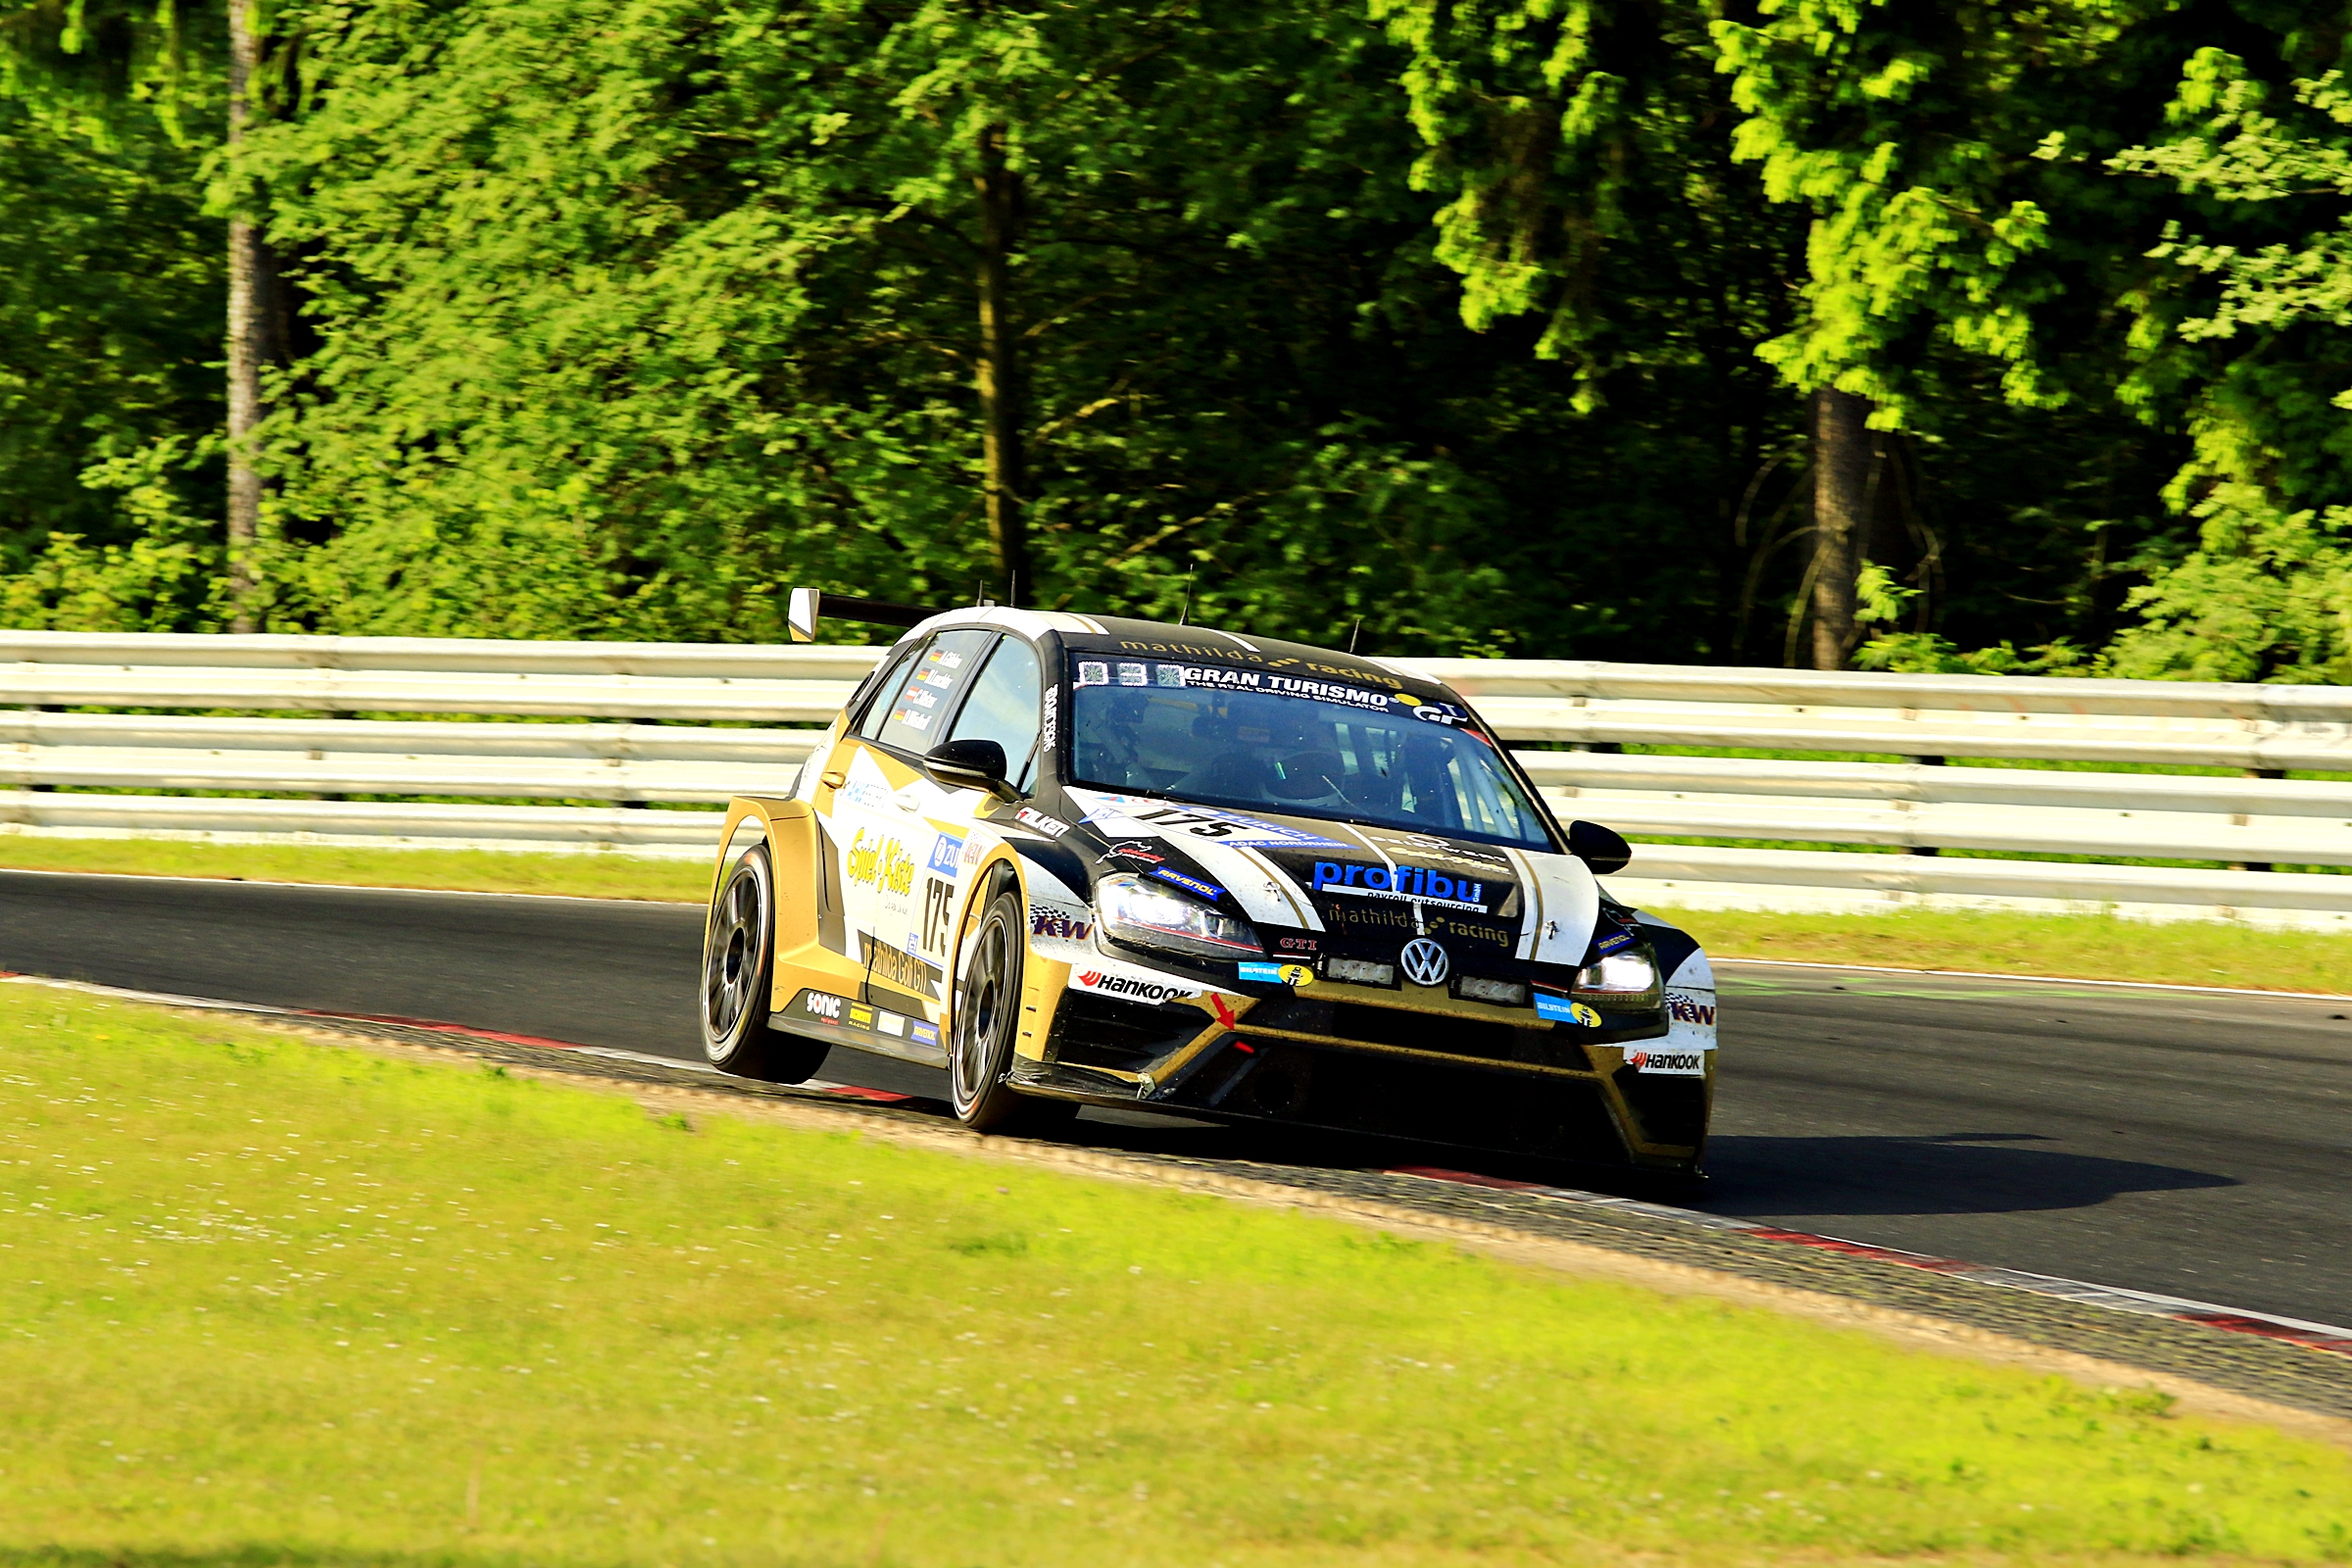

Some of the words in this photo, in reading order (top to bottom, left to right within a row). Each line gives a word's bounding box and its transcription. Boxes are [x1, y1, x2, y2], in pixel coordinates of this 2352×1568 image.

[1121, 639, 1261, 663] mathilda
[1306, 661, 1402, 690] racing
[1184, 667, 1260, 686] GRAN
[1268, 675, 1389, 707] TURISMO
[1256, 687, 1311, 699] DRIVING
[1313, 696, 1390, 712] SIMULATOR
[1016, 807, 1070, 838] FALKEN
[1132, 808, 1251, 838] 175
[1222, 815, 1318, 841] ZURICH
[1158, 868, 1216, 897] RAVENOL
[1313, 861, 1483, 903] profibu
[1368, 890, 1406, 903] payroll
[1410, 898, 1480, 913] outsourcing
[923, 877, 955, 957] 175
[1033, 915, 1095, 941] KW
[1330, 907, 1421, 930] mathilda
[1449, 921, 1509, 948] racing
[1280, 937, 1317, 951] GTI
[1239, 965, 1279, 975] BILSTEIN
[1537, 1002, 1571, 1013] BILSTEIN
[1672, 1002, 1715, 1026] KW
